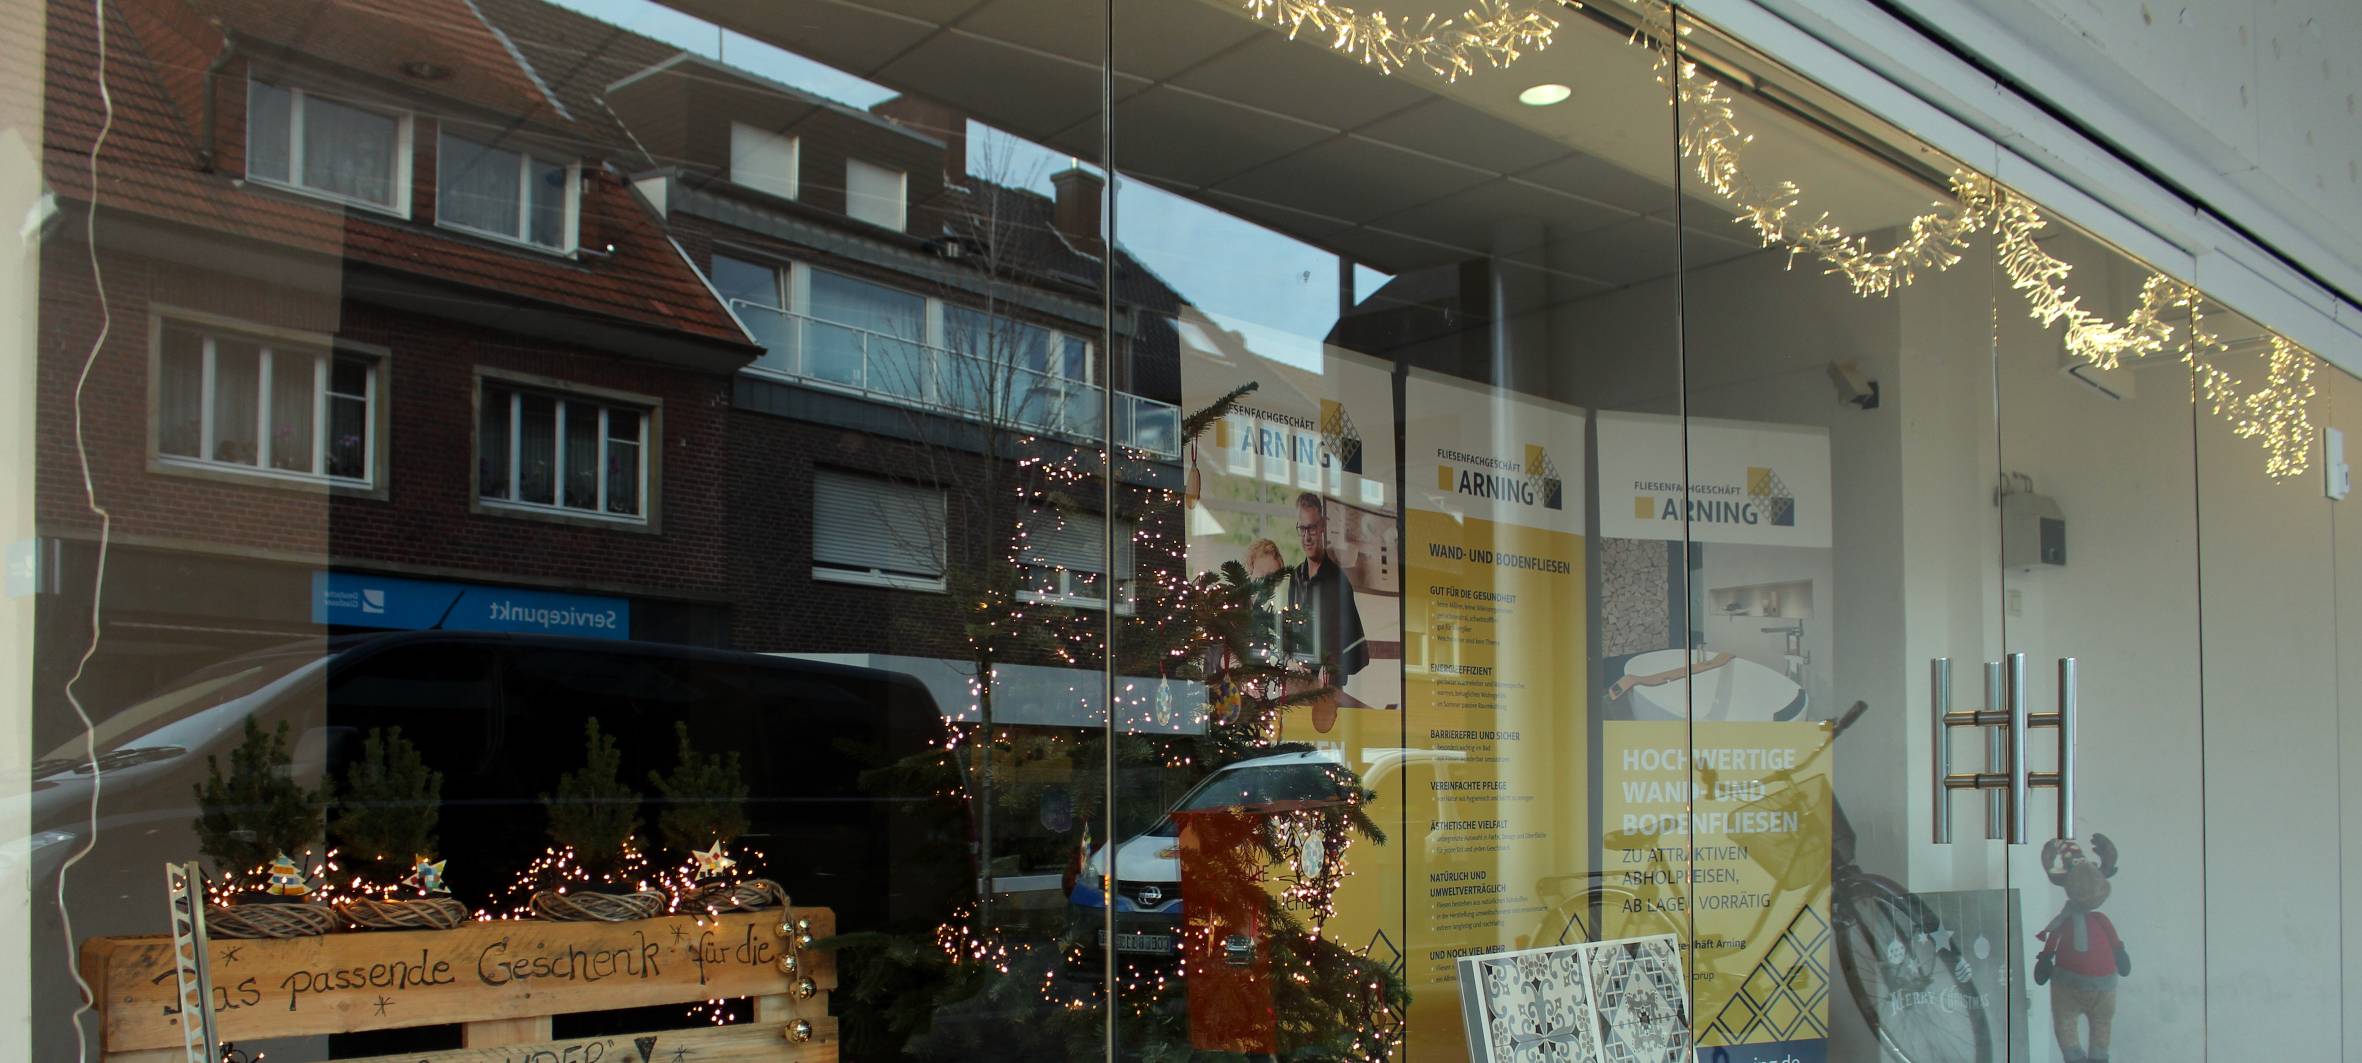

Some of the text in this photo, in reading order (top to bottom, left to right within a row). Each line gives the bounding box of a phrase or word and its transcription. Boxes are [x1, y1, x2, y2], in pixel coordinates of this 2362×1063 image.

[1241, 425, 1331, 469] ARNING
[1437, 447, 1521, 473] FLIESENFACHGESCHÄFT
[1458, 469, 1534, 506] ARNING
[1661, 498, 1758, 525] ARNING
[1429, 543, 1571, 575] WAND- UND BODENFLIESEN
[1429, 585, 1517, 604] GUT FÜR DIE GESUNDHEIT
[1430, 729, 1520, 741] BARRIEREFREI UND SICHER
[1430, 781, 1508, 791] VEREINFACHTE PFLEGE
[1430, 818, 1508, 831] ÄSTHETISCHE VIELFALT
[1622, 811, 1799, 836] BODENFLIESEN
[1622, 848, 1643, 863] ZU
[1430, 870, 1487, 882] NATÜRLICH UND
[1622, 869, 1740, 886] ABHOLPEISEN,
[1430, 883, 1507, 898] UMWELTVERTRÄGLICH
[1622, 898, 1642, 913] AB
[1698, 890, 1771, 910] VORRÄTIG
[1430, 944, 1506, 960] UND NOCH VIEL MEHR
[1716, 938, 1747, 950] Arning
[280, 948, 455, 1011] passende
[477, 930, 660, 986] Geschenk
[688, 930, 728, 985] für
[736, 923, 776, 966] die
